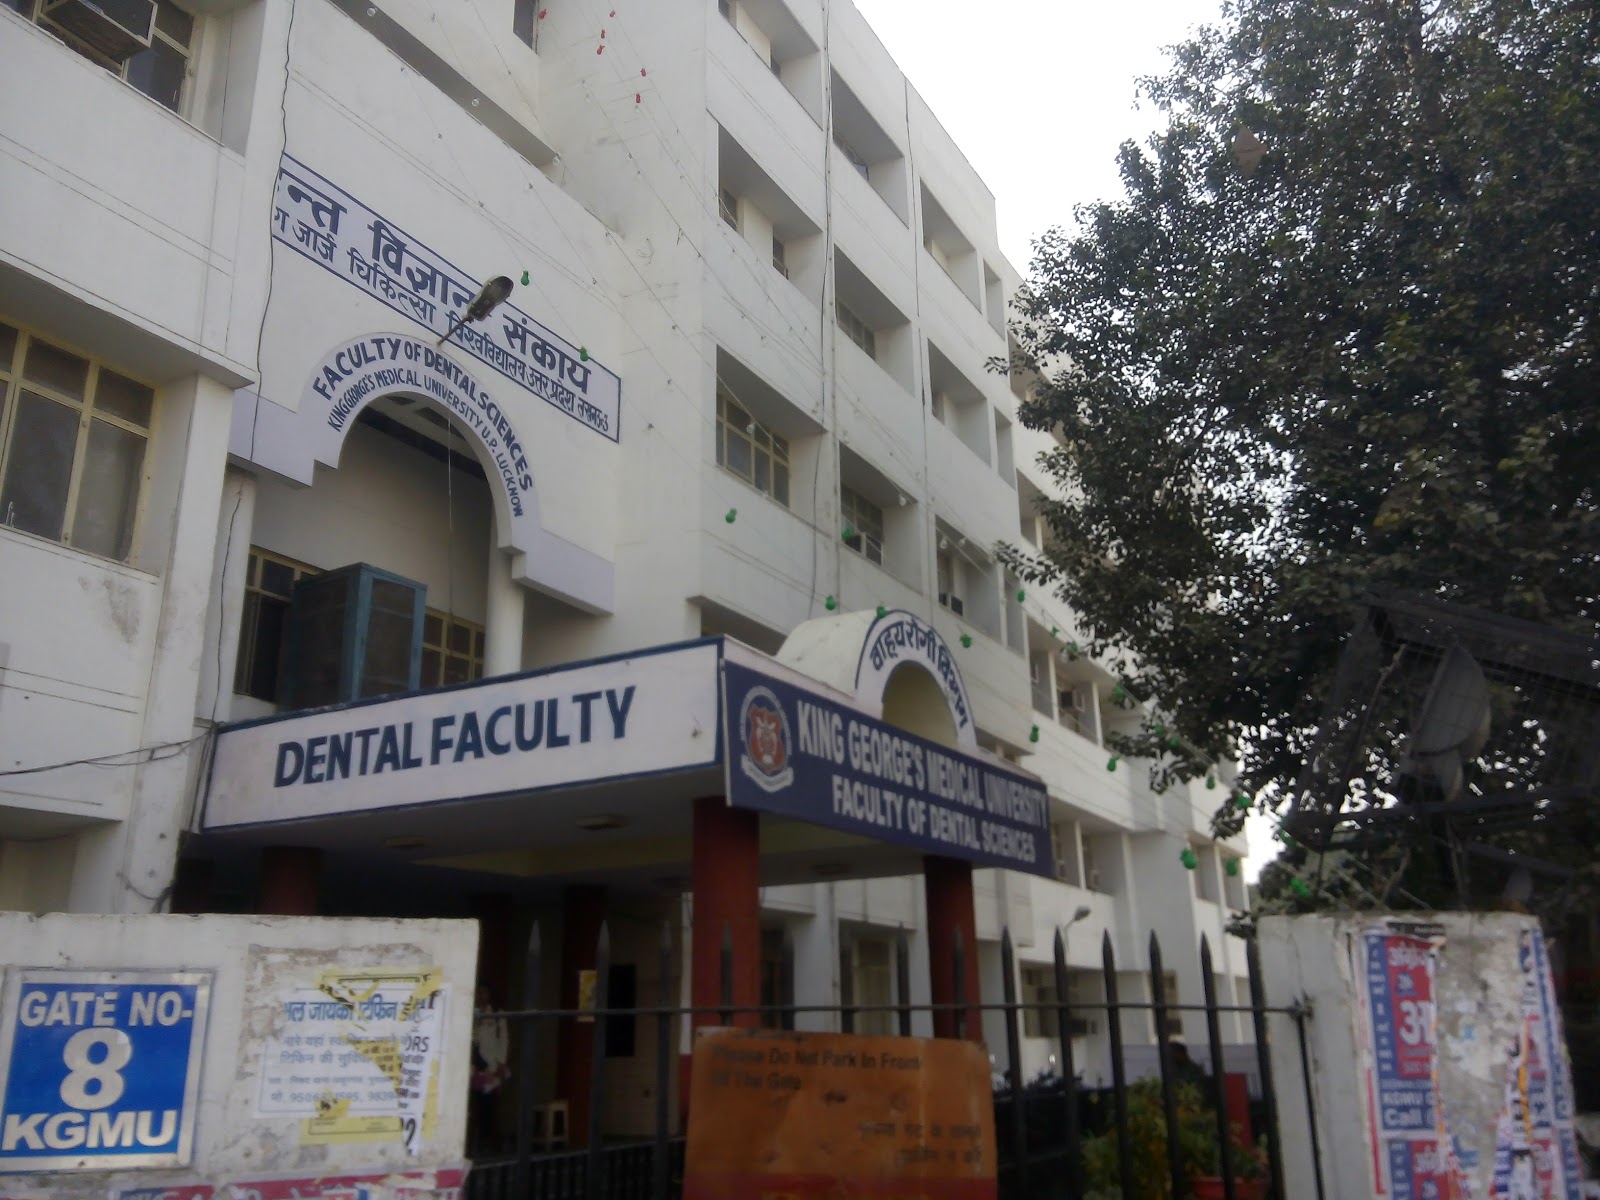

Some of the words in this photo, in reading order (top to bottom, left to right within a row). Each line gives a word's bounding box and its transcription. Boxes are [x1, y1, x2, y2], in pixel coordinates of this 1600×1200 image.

[347, 247, 437, 324] चिकित्सा
[503, 314, 591, 394] संकाय
[312, 337, 401, 400] FACULTY
[404, 340, 423, 362] OF
[424, 346, 476, 402] DENTAL
[477, 392, 533, 492] SCIENCES
[343, 374, 376, 409] GEORGE'S
[375, 367, 421, 388] MEDICAL
[424, 375, 483, 429] UNIVERSITY
[496, 453, 523, 517] LUCKNOW
[274, 721, 421, 788] DENTAL
[430, 686, 636, 765] FACULTY
[797, 699, 845, 765] KING
[848, 719, 925, 791] GEORGE'S
[926, 750, 984, 810] MEDICAL
[984, 771, 1048, 830] UNIVERSITY
[832, 774, 904, 829] FACULTY
[907, 798, 926, 836] OF
[929, 803, 980, 850] DENTAL
[981, 820, 1036, 863] SCIENCES
[20, 990, 116, 1027] GATE
[129, 991, 192, 1026] NO-
[60, 1027, 133, 1110] 8
[824, 1052, 857, 1068] Park
[881, 1054, 921, 1070] Front
[2, 1109, 177, 1151] KGMU
